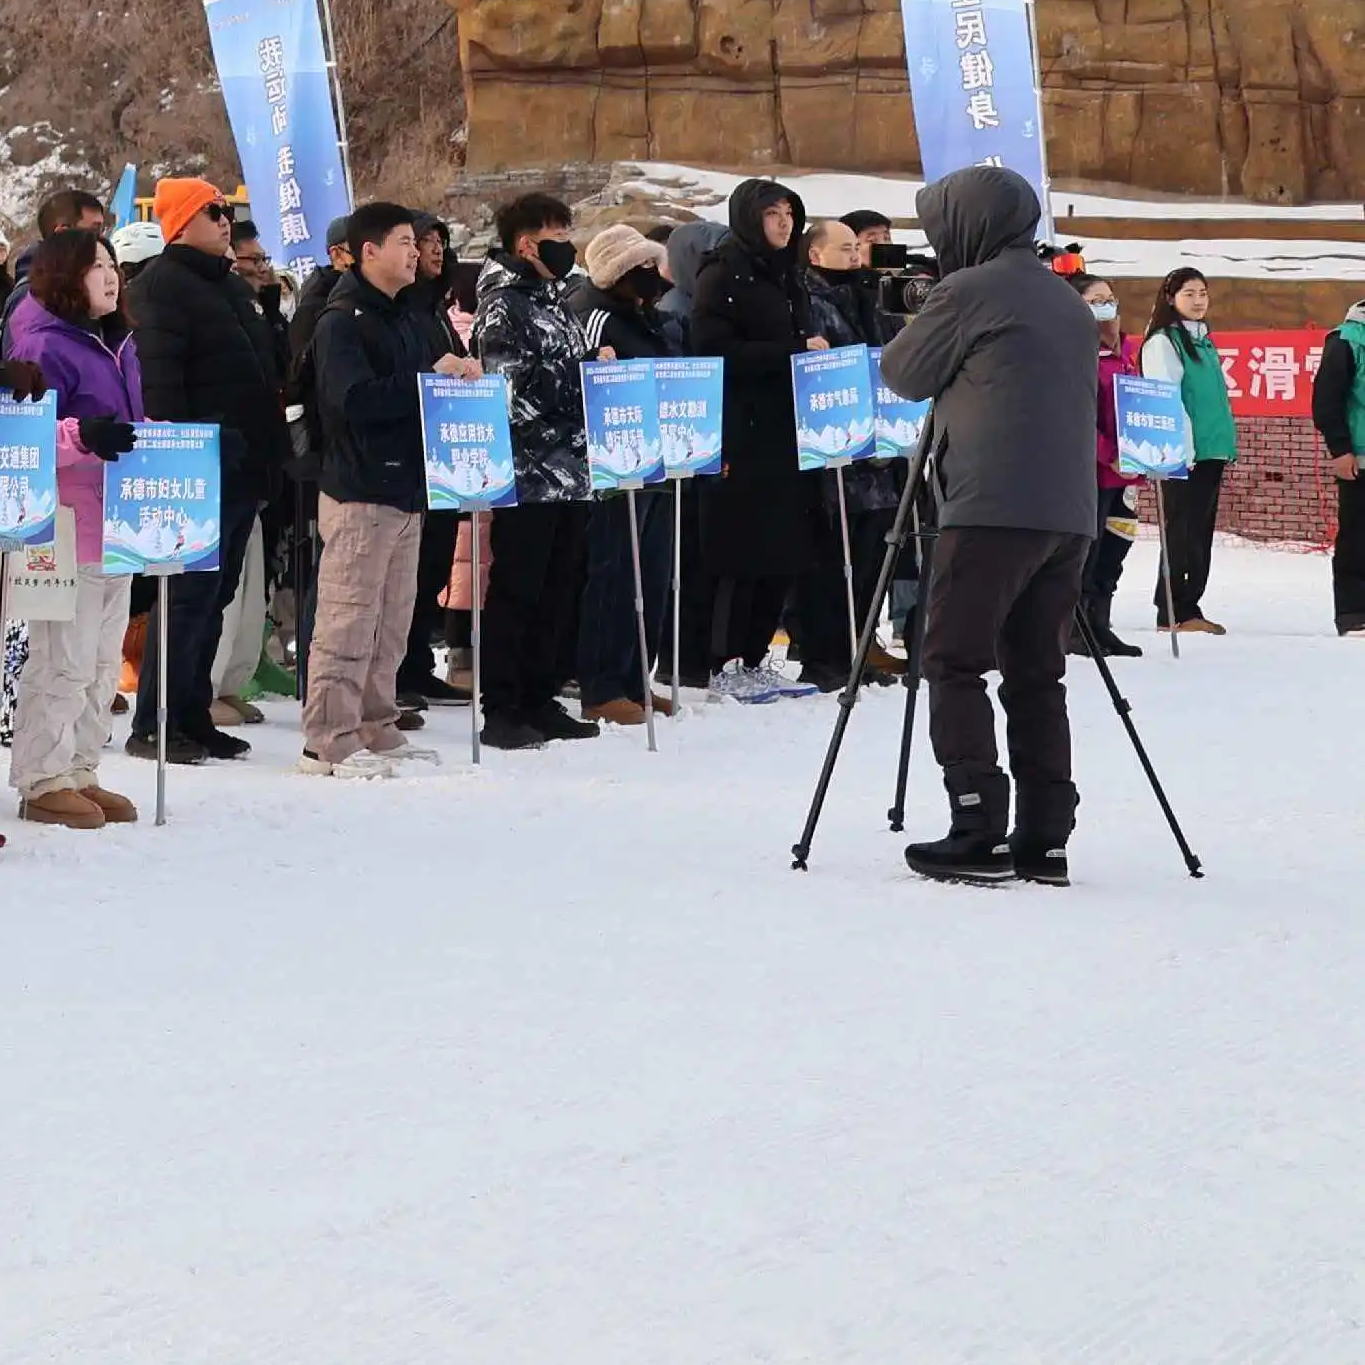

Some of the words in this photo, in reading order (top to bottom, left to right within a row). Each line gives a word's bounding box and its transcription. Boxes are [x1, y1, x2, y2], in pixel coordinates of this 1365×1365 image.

[120, 477, 206, 502] 承德市妇女儿童
[139, 506, 188, 527] 活动中心
